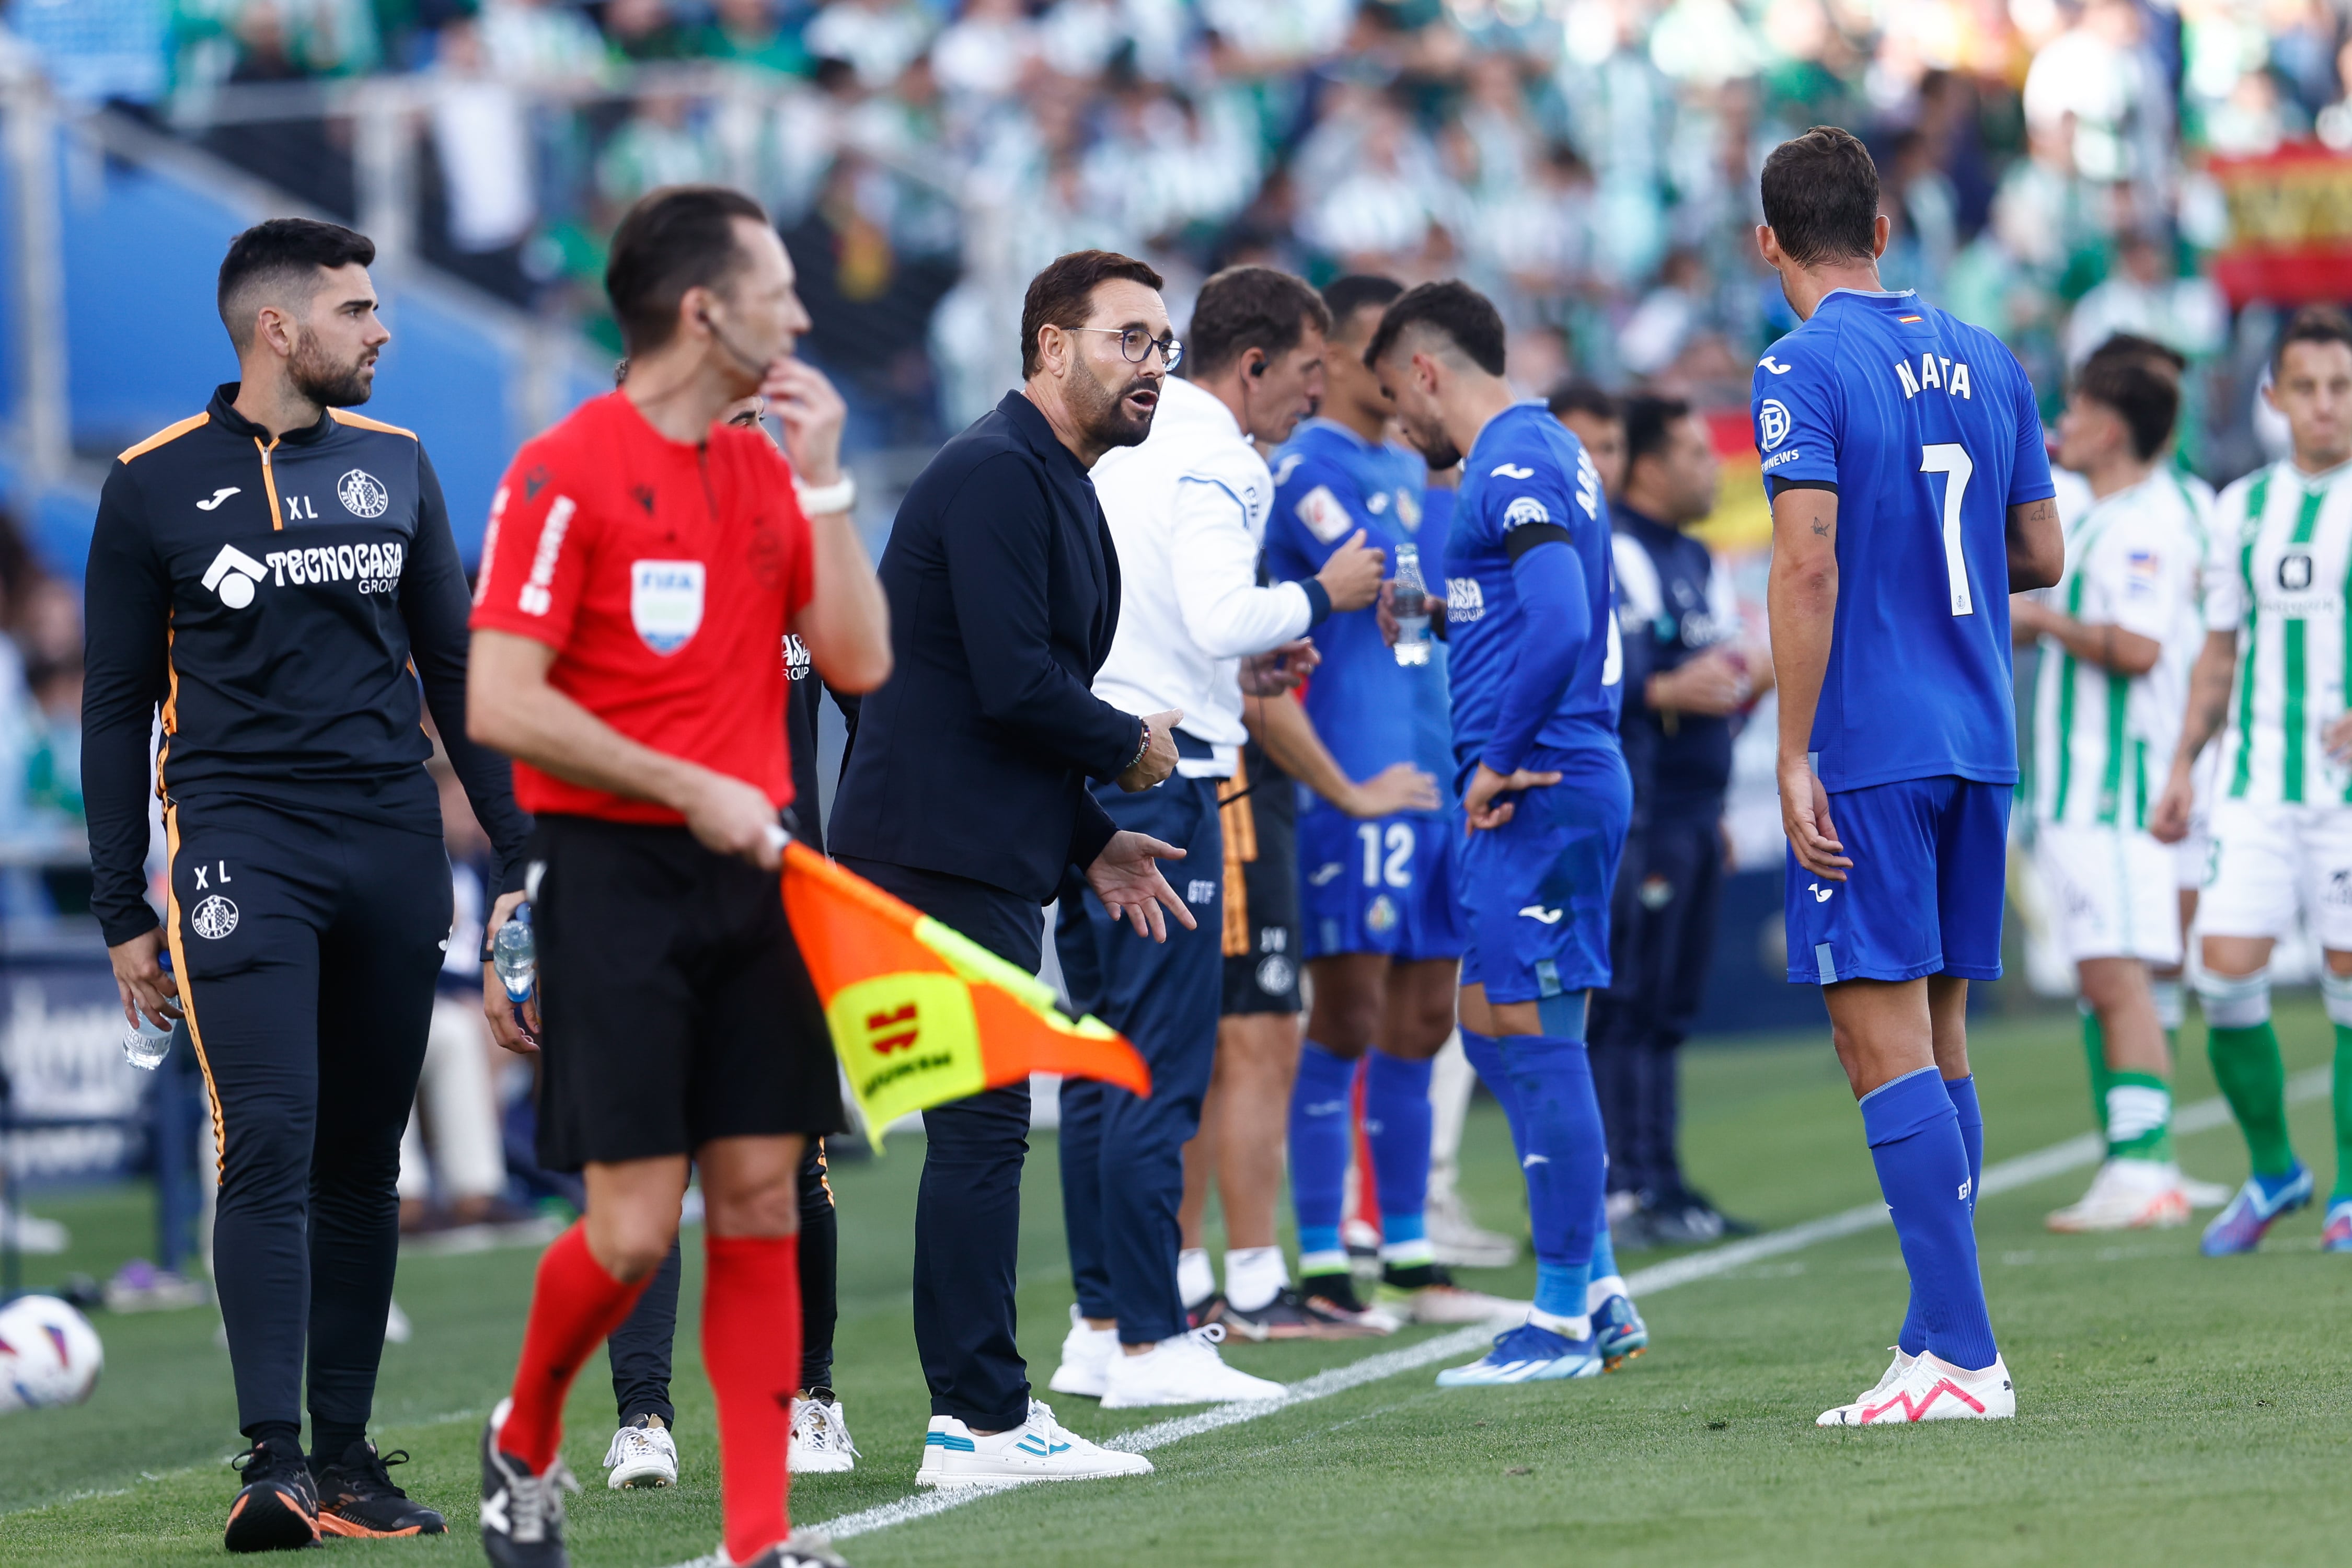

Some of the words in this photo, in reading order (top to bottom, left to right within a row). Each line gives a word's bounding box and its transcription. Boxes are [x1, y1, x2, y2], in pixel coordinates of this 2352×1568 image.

[286, 496, 318, 521] XL
[340, 491, 362, 515] GETAFE
[1919, 443, 1973, 617] 7
[266, 543, 402, 587] TECNOCASA
[358, 578, 398, 595] GROUP
[782, 666, 810, 681] ROUP
[1357, 822, 1415, 888] 12
[194, 917, 211, 937] GETAFE
